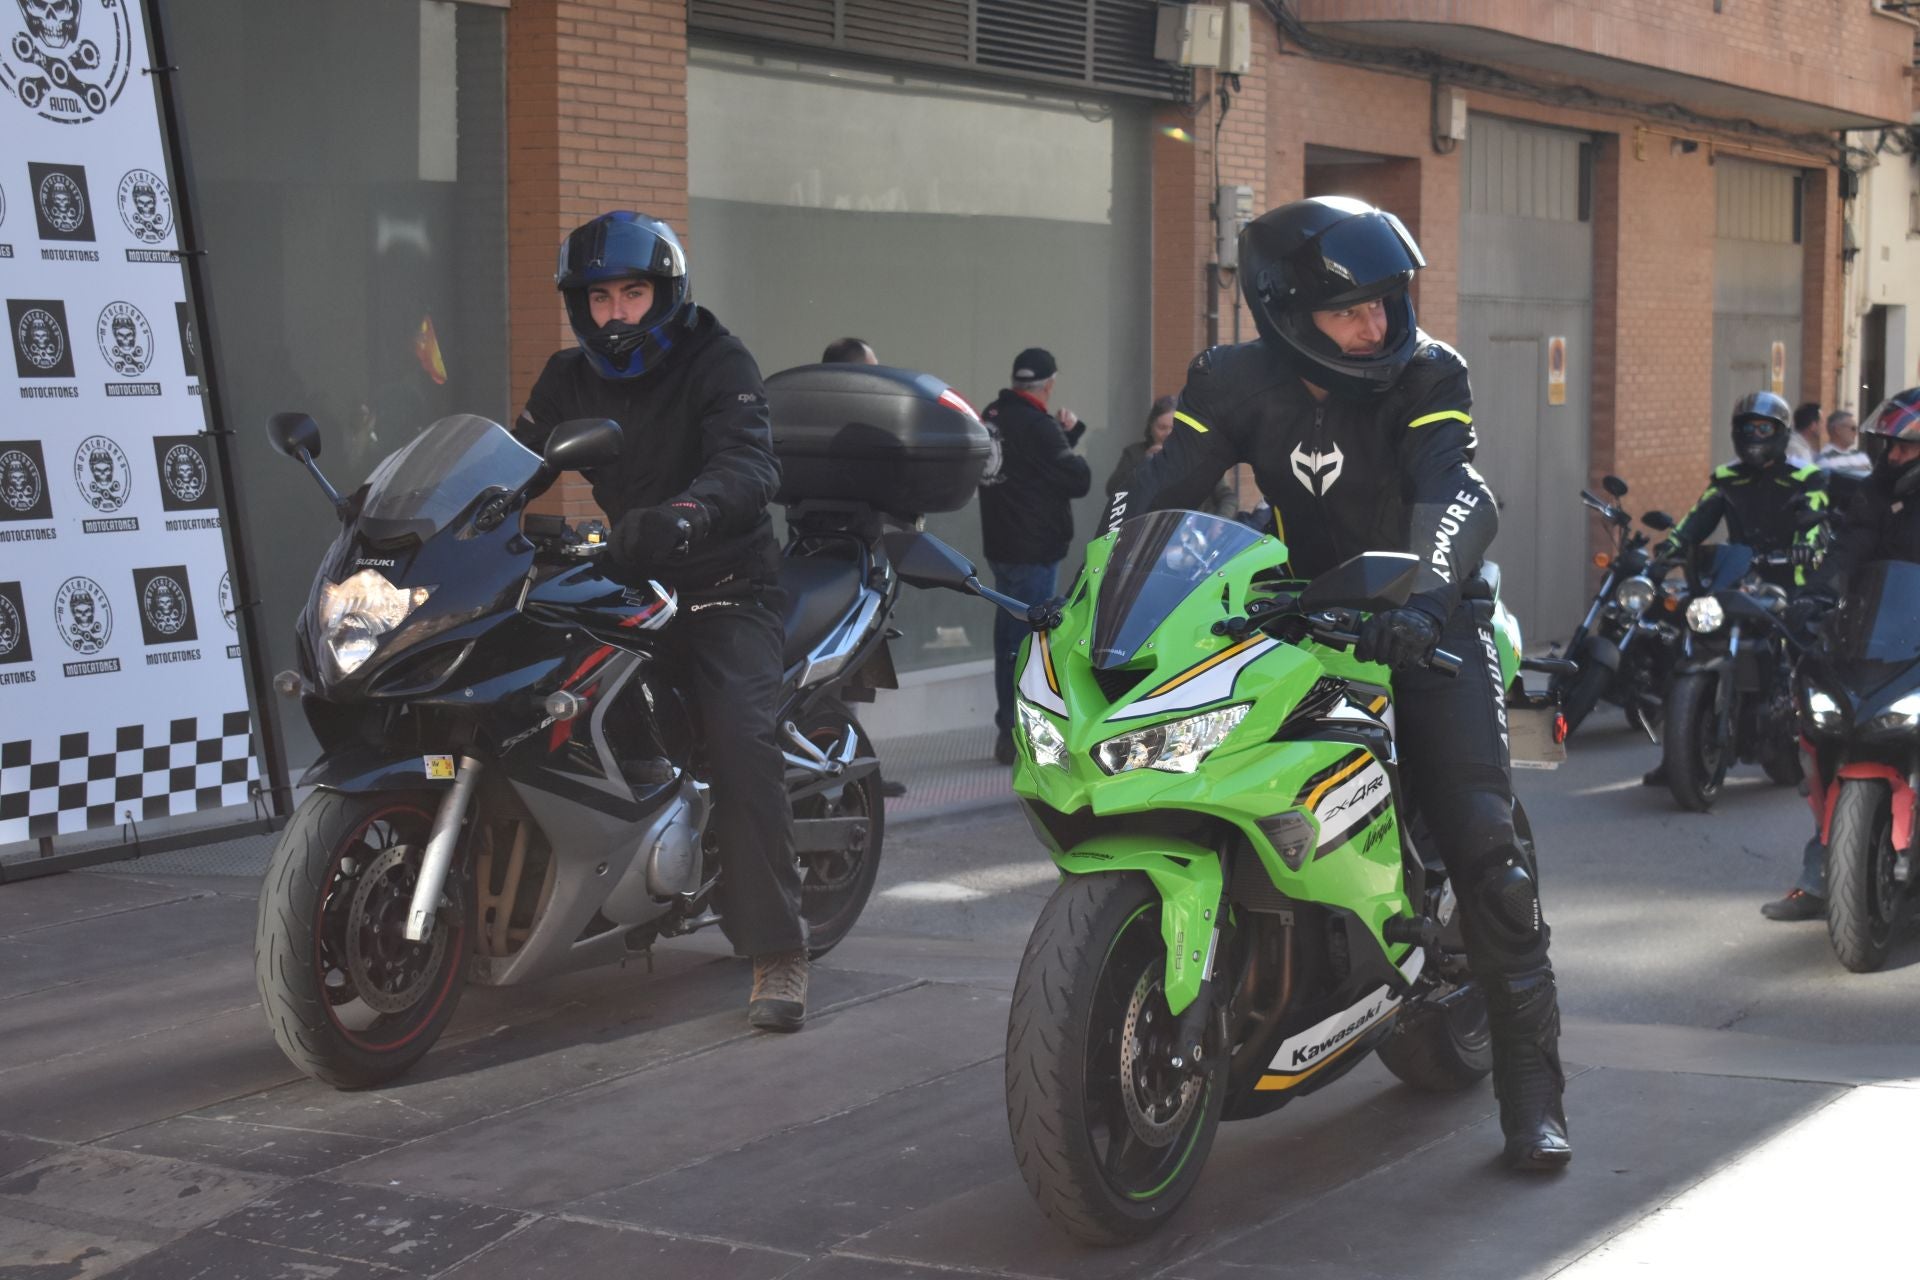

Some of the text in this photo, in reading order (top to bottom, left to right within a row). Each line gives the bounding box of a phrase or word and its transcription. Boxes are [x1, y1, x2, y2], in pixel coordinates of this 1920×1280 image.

[50, 97, 81, 113] AUTOL
[41, 249, 99, 262] MOTOCATONES
[20, 386, 79, 399] MOTOCATONES
[108, 384, 159, 396] MOTOCATONES
[1111, 491, 1129, 532] ARM
[85, 519, 137, 532] MOTOCATONES
[165, 518, 222, 532] MOTOCATONES
[355, 558, 395, 567] SUZUKI
[146, 648, 201, 666] MOTOCATONES
[66, 660, 119, 676] MOTOCATONES
[1477, 627, 1509, 751] ARMURE
[1291, 1000, 1384, 1067] Kawasaki
